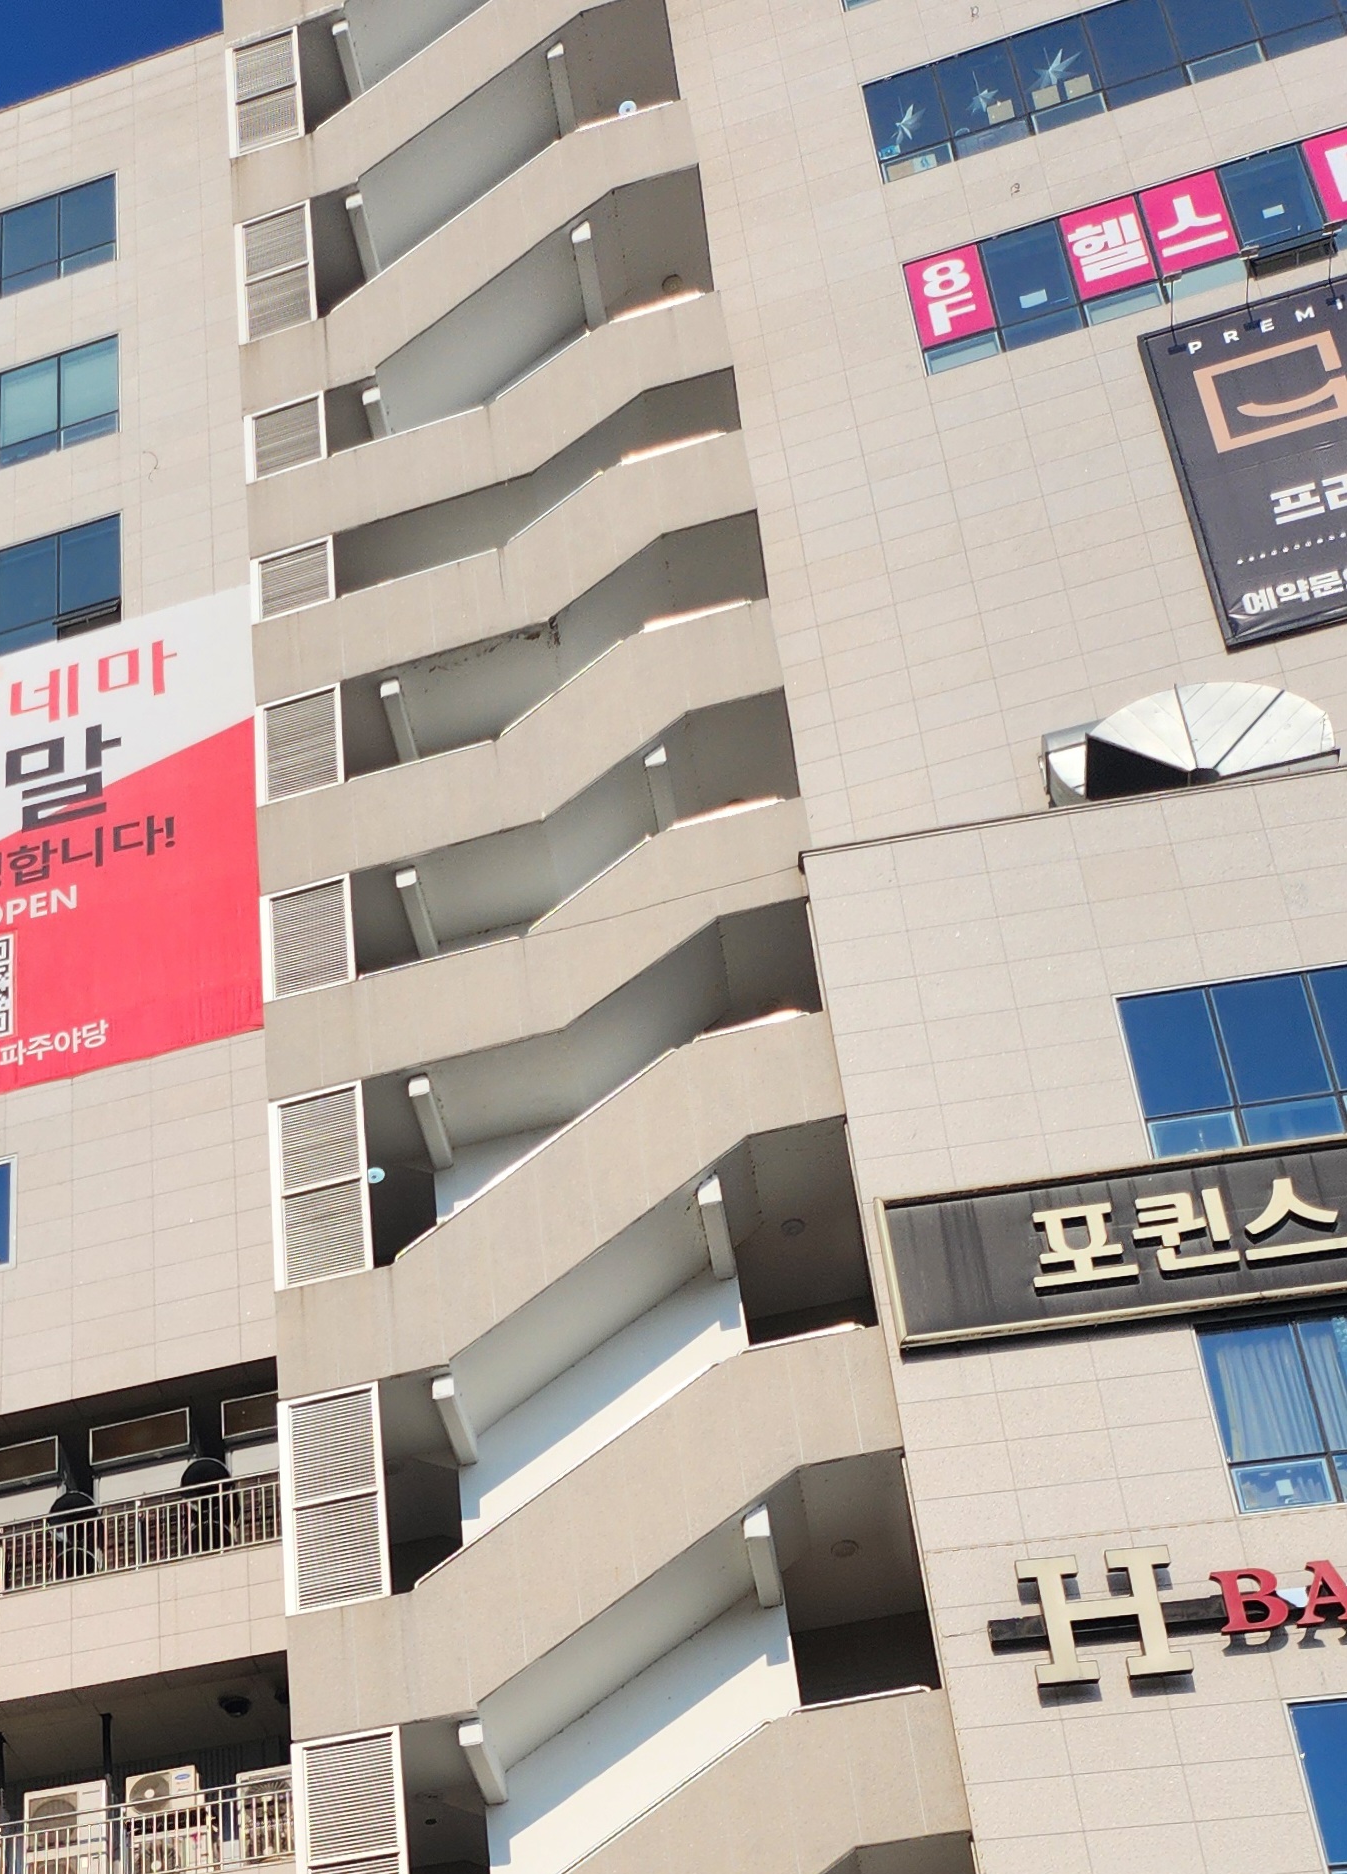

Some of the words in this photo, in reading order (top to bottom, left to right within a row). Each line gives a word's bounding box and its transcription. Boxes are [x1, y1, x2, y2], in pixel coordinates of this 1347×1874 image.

[1067, 193, 1229, 283] 헬스
[921, 258, 976, 337] 8F
[0, 1019, 109, 1067] 파주야당
[1032, 1177, 1347, 1290] 포퀸스
[1014, 1544, 1195, 1686] H
